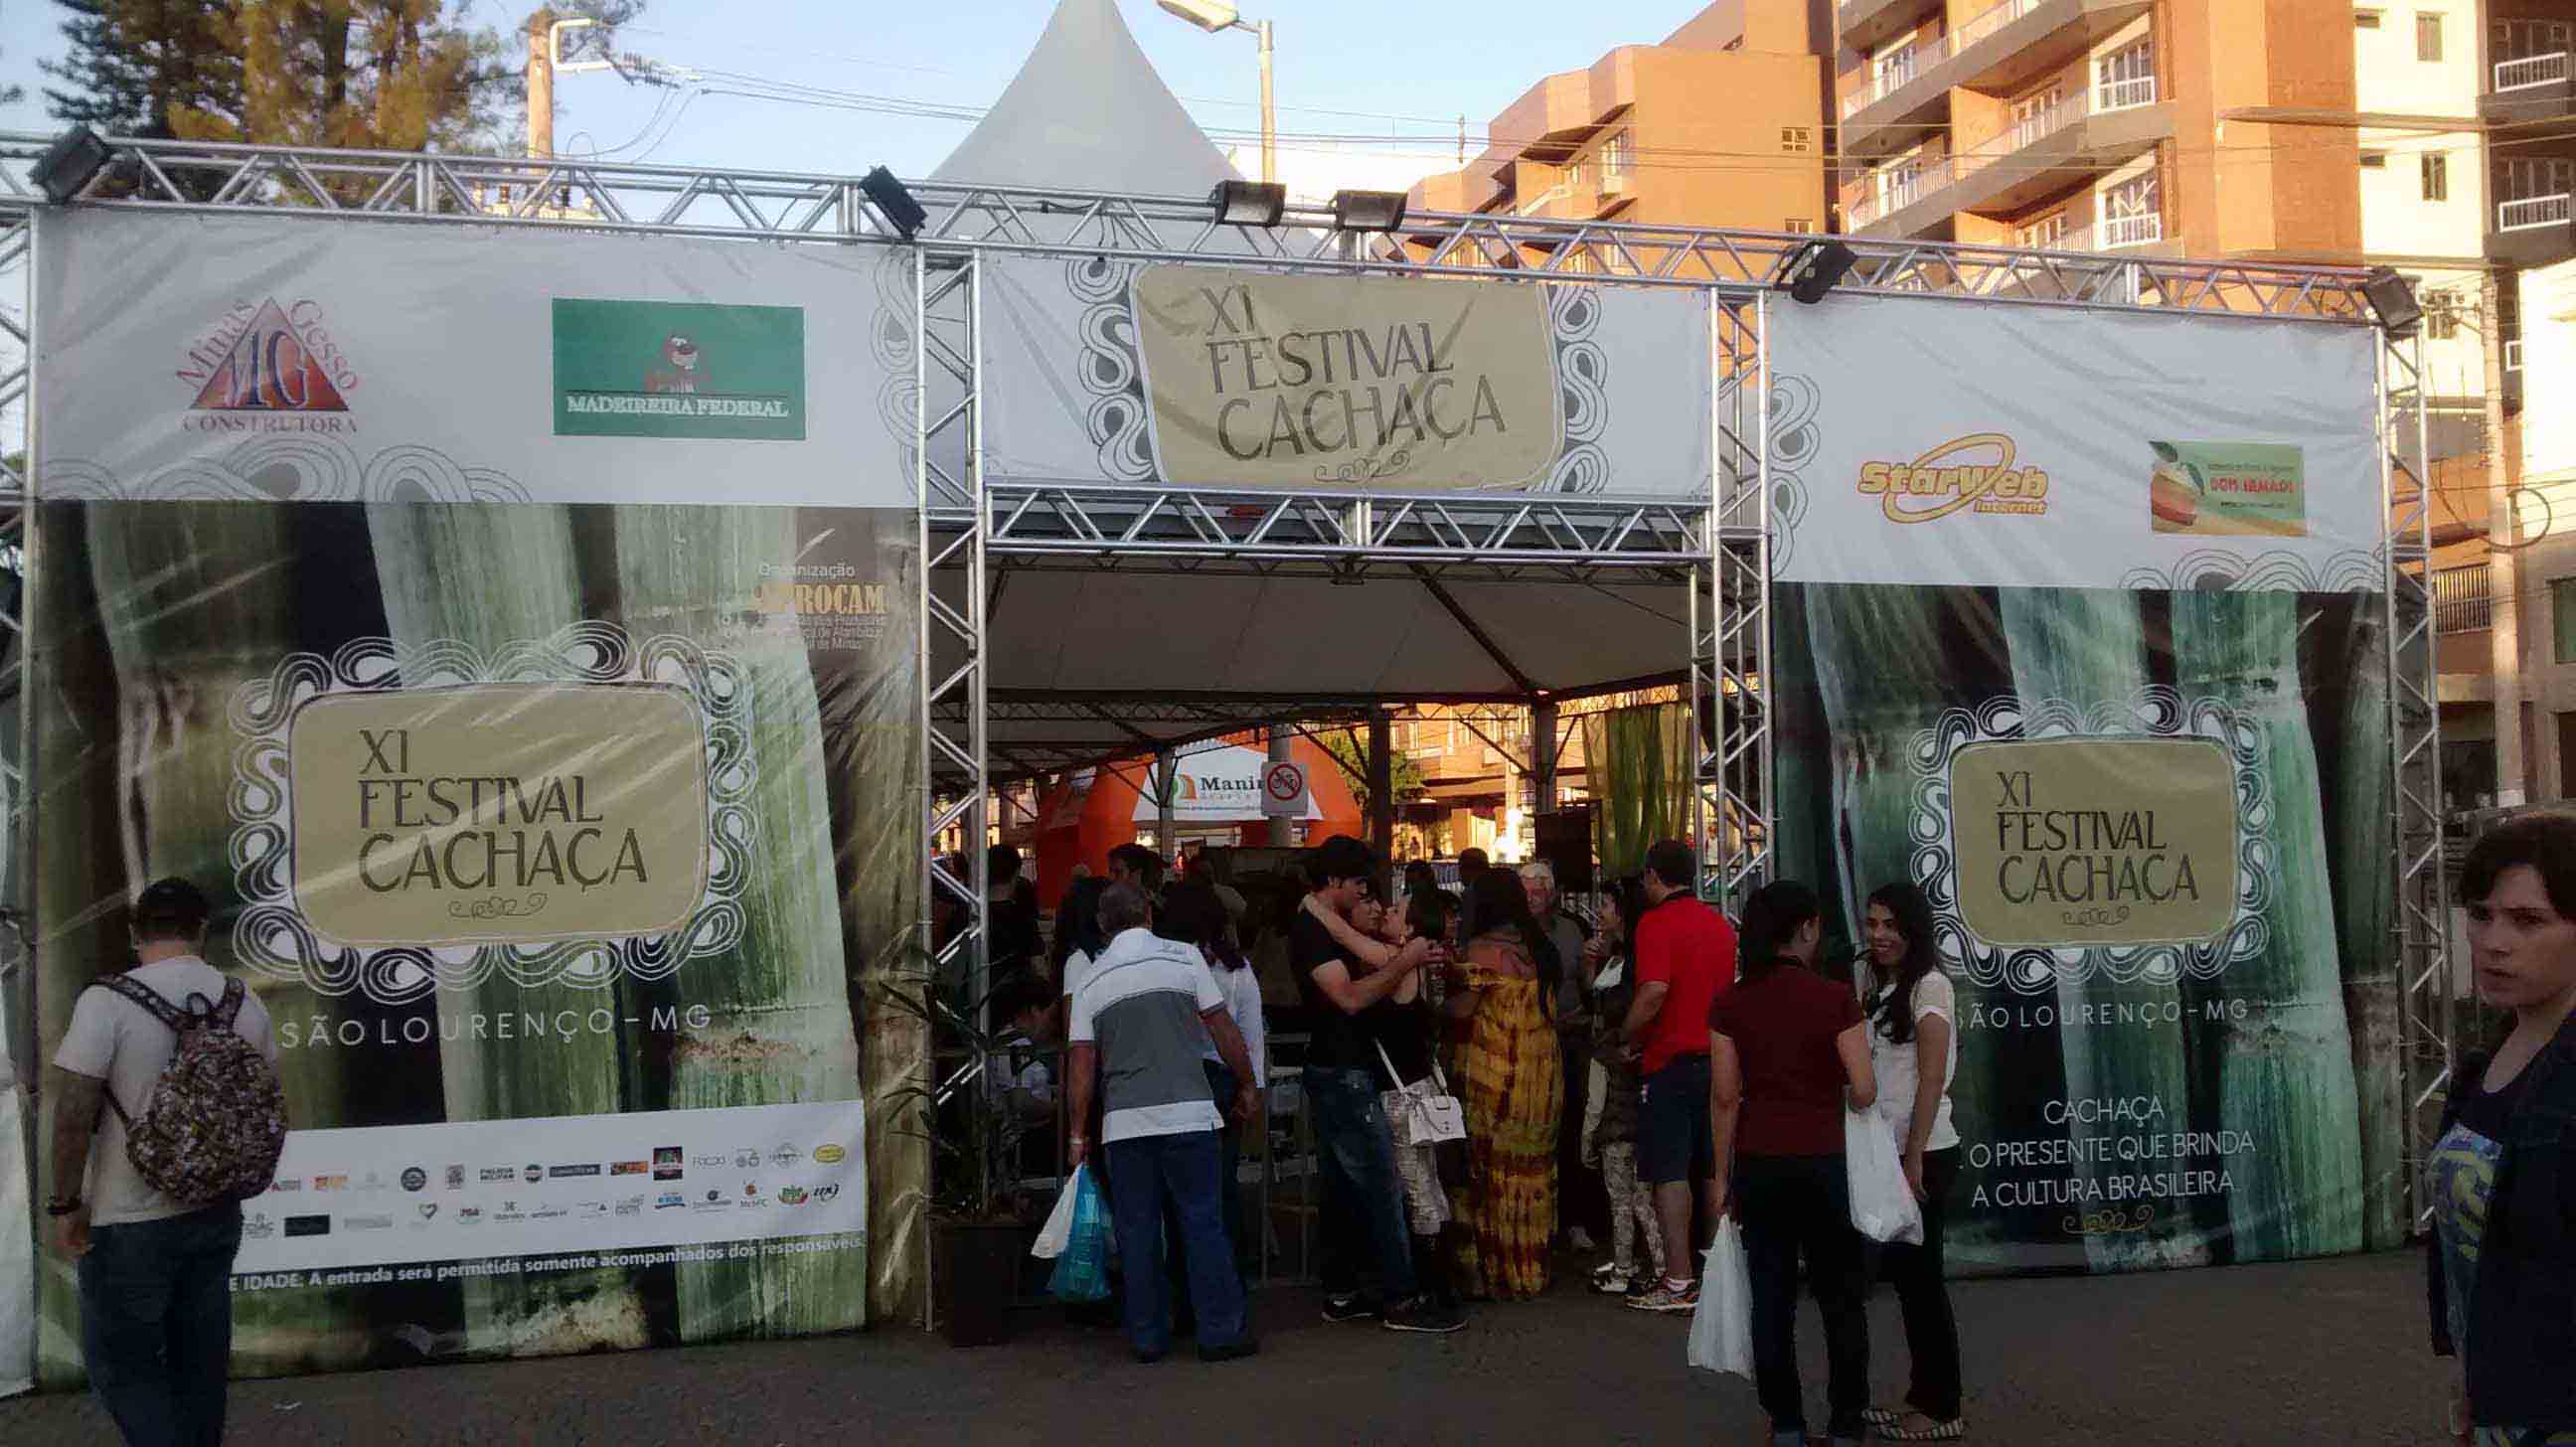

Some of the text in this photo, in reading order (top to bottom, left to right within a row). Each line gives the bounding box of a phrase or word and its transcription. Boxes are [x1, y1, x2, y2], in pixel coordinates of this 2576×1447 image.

[1201, 284, 1255, 336] XI
[177, 298, 358, 390] Minas Gesso
[1206, 322, 1454, 394] FESTIVAL
[566, 396, 788, 417] MADEIREIRA FEDERAL
[1218, 374, 1507, 461] CACHAÇA
[759, 563, 856, 578] Onização
[359, 729, 408, 774] XI
[358, 775, 603, 829] FESTIVAL
[1997, 771, 2032, 807] XI
[1997, 810, 2168, 852] FESTIVAL
[359, 827, 648, 895] CACHAÇA
[1999, 854, 2199, 904] CACHAÇA
[280, 1013, 366, 1049] SÃO
[2044, 1095, 2165, 1127] CACHAÇA
[1970, 1131, 2256, 1168] O PRESENTE QUE BRINDA
[1972, 1171, 2235, 1207] A CULTURA BRASILEIRA
[309, 1271, 322, 1285] A
[327, 1268, 393, 1285] entrada
[398, 1267, 431, 1281] será
[437, 1258, 520, 1282] permitida
[525, 1256, 596, 1272] somente
[600, 1244, 724, 1268] acompanhados
[728, 1241, 757, 1258] dos
